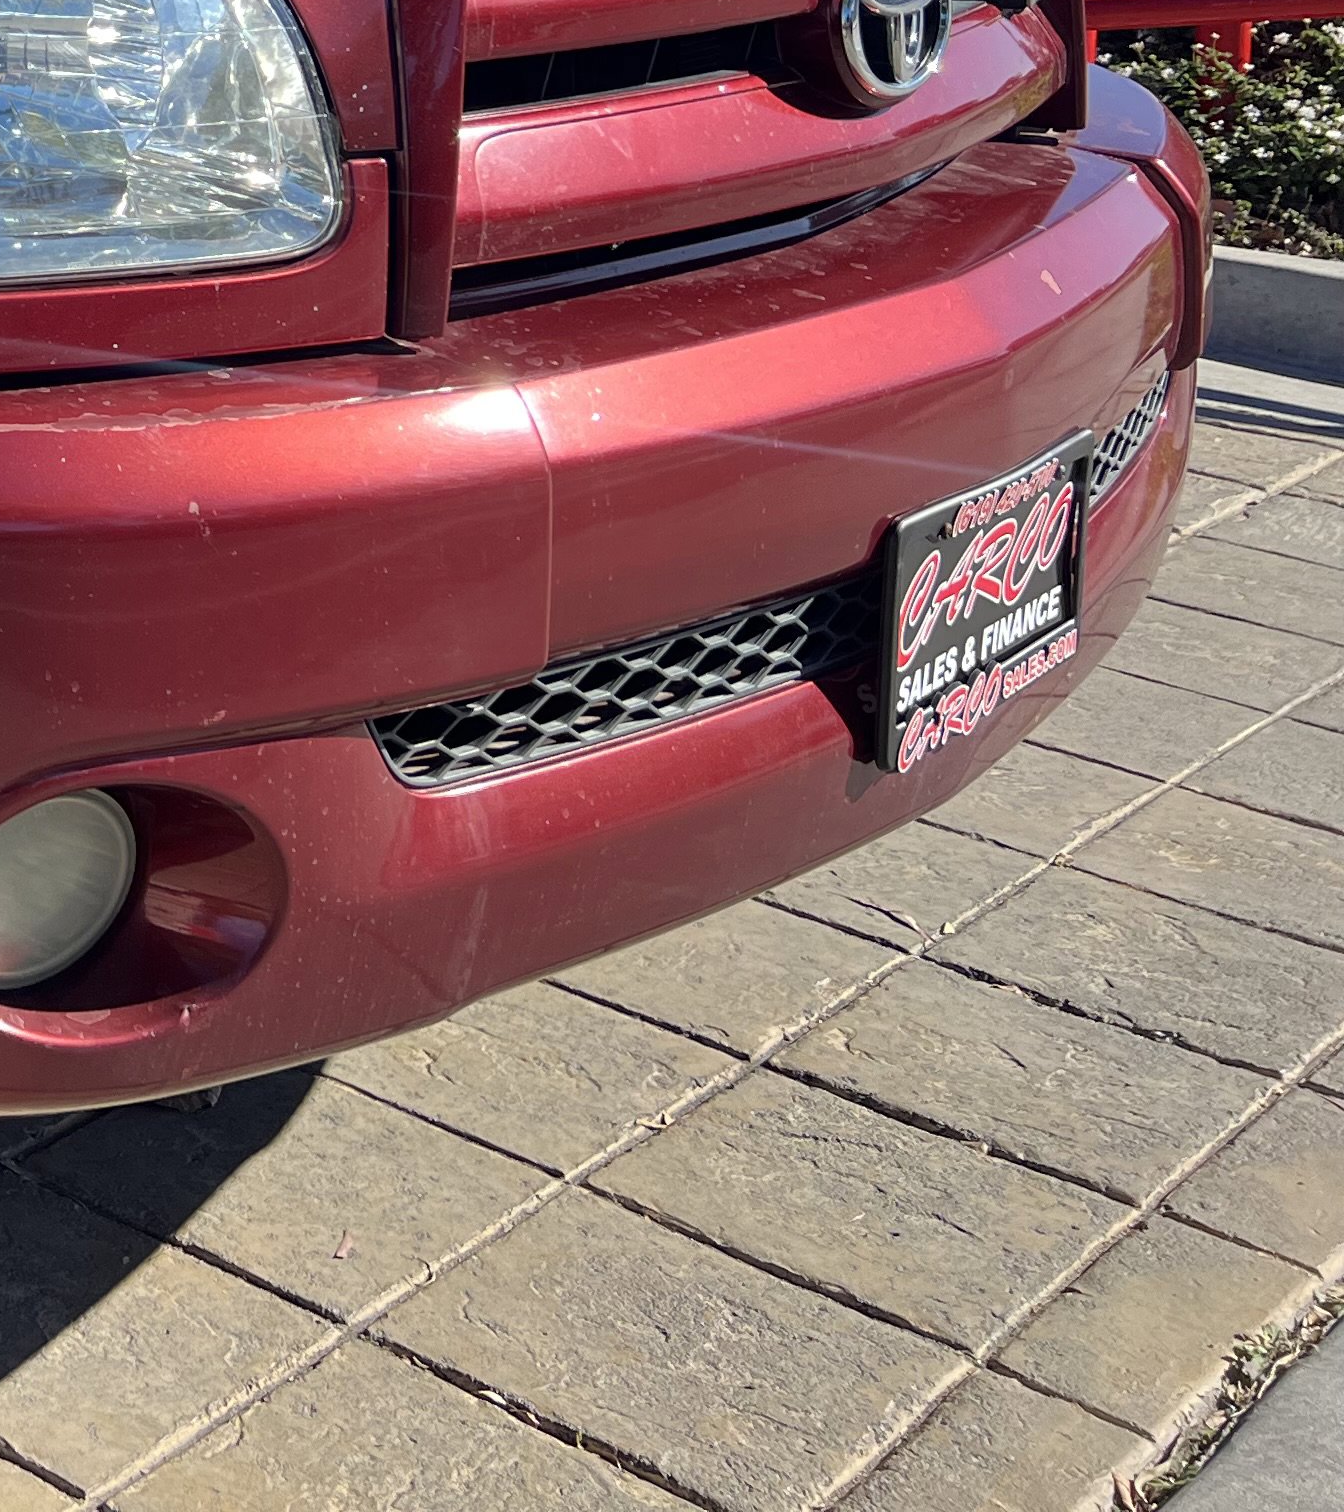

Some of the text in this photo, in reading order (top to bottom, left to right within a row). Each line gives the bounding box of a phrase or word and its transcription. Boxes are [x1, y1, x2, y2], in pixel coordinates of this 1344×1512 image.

[896, 584, 1063, 713] SALES & FINANCE
[897, 481, 1074, 672] CARCO
[897, 628, 1078, 774] CARCO SALES.COM
